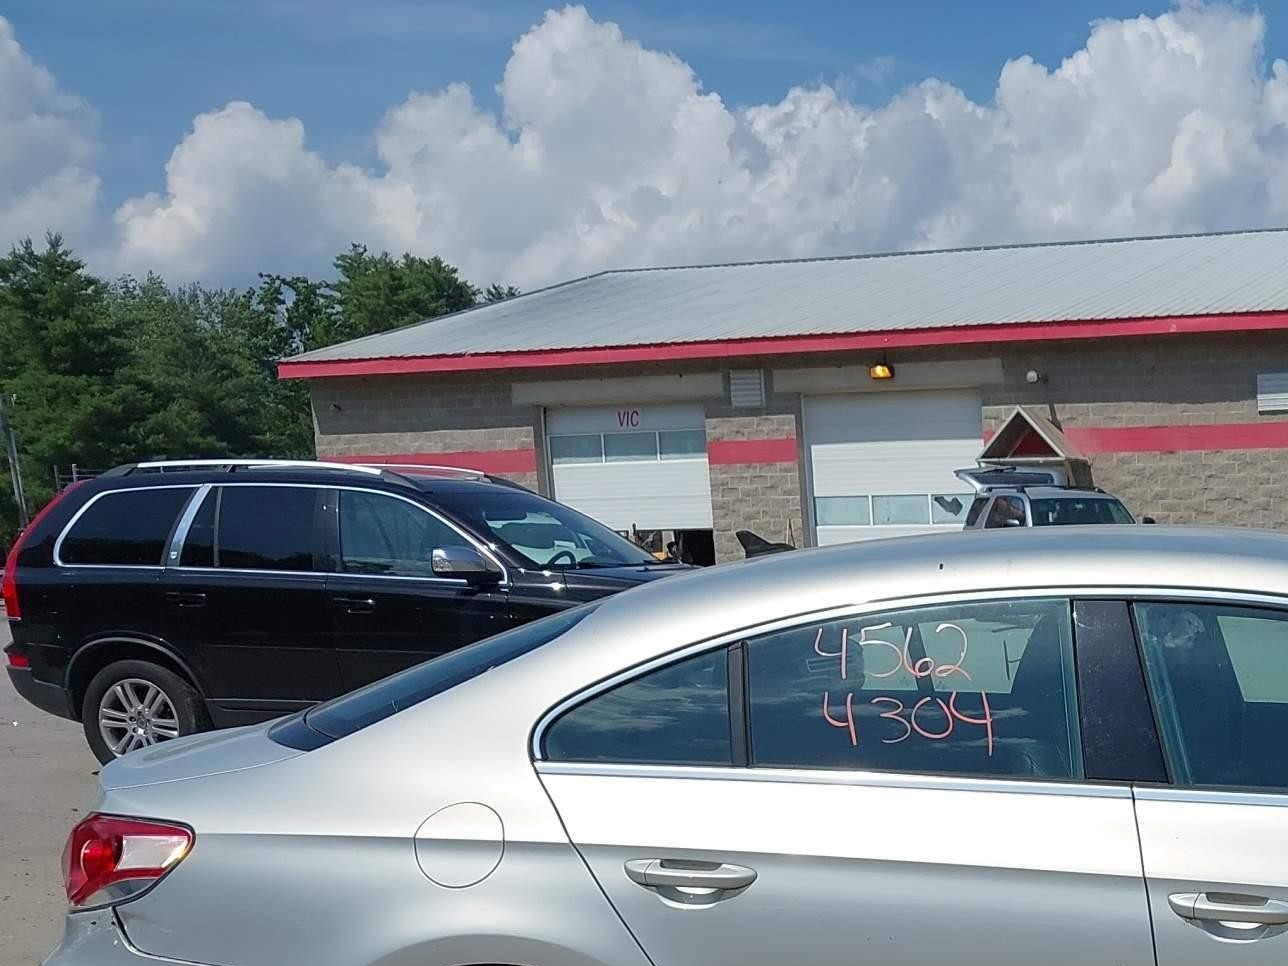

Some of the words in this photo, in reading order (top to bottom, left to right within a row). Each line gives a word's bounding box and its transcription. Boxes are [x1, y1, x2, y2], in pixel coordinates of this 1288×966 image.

[617, 410, 639, 427] VIC
[814, 621, 972, 680] 4562
[823, 689, 993, 757] 4304
